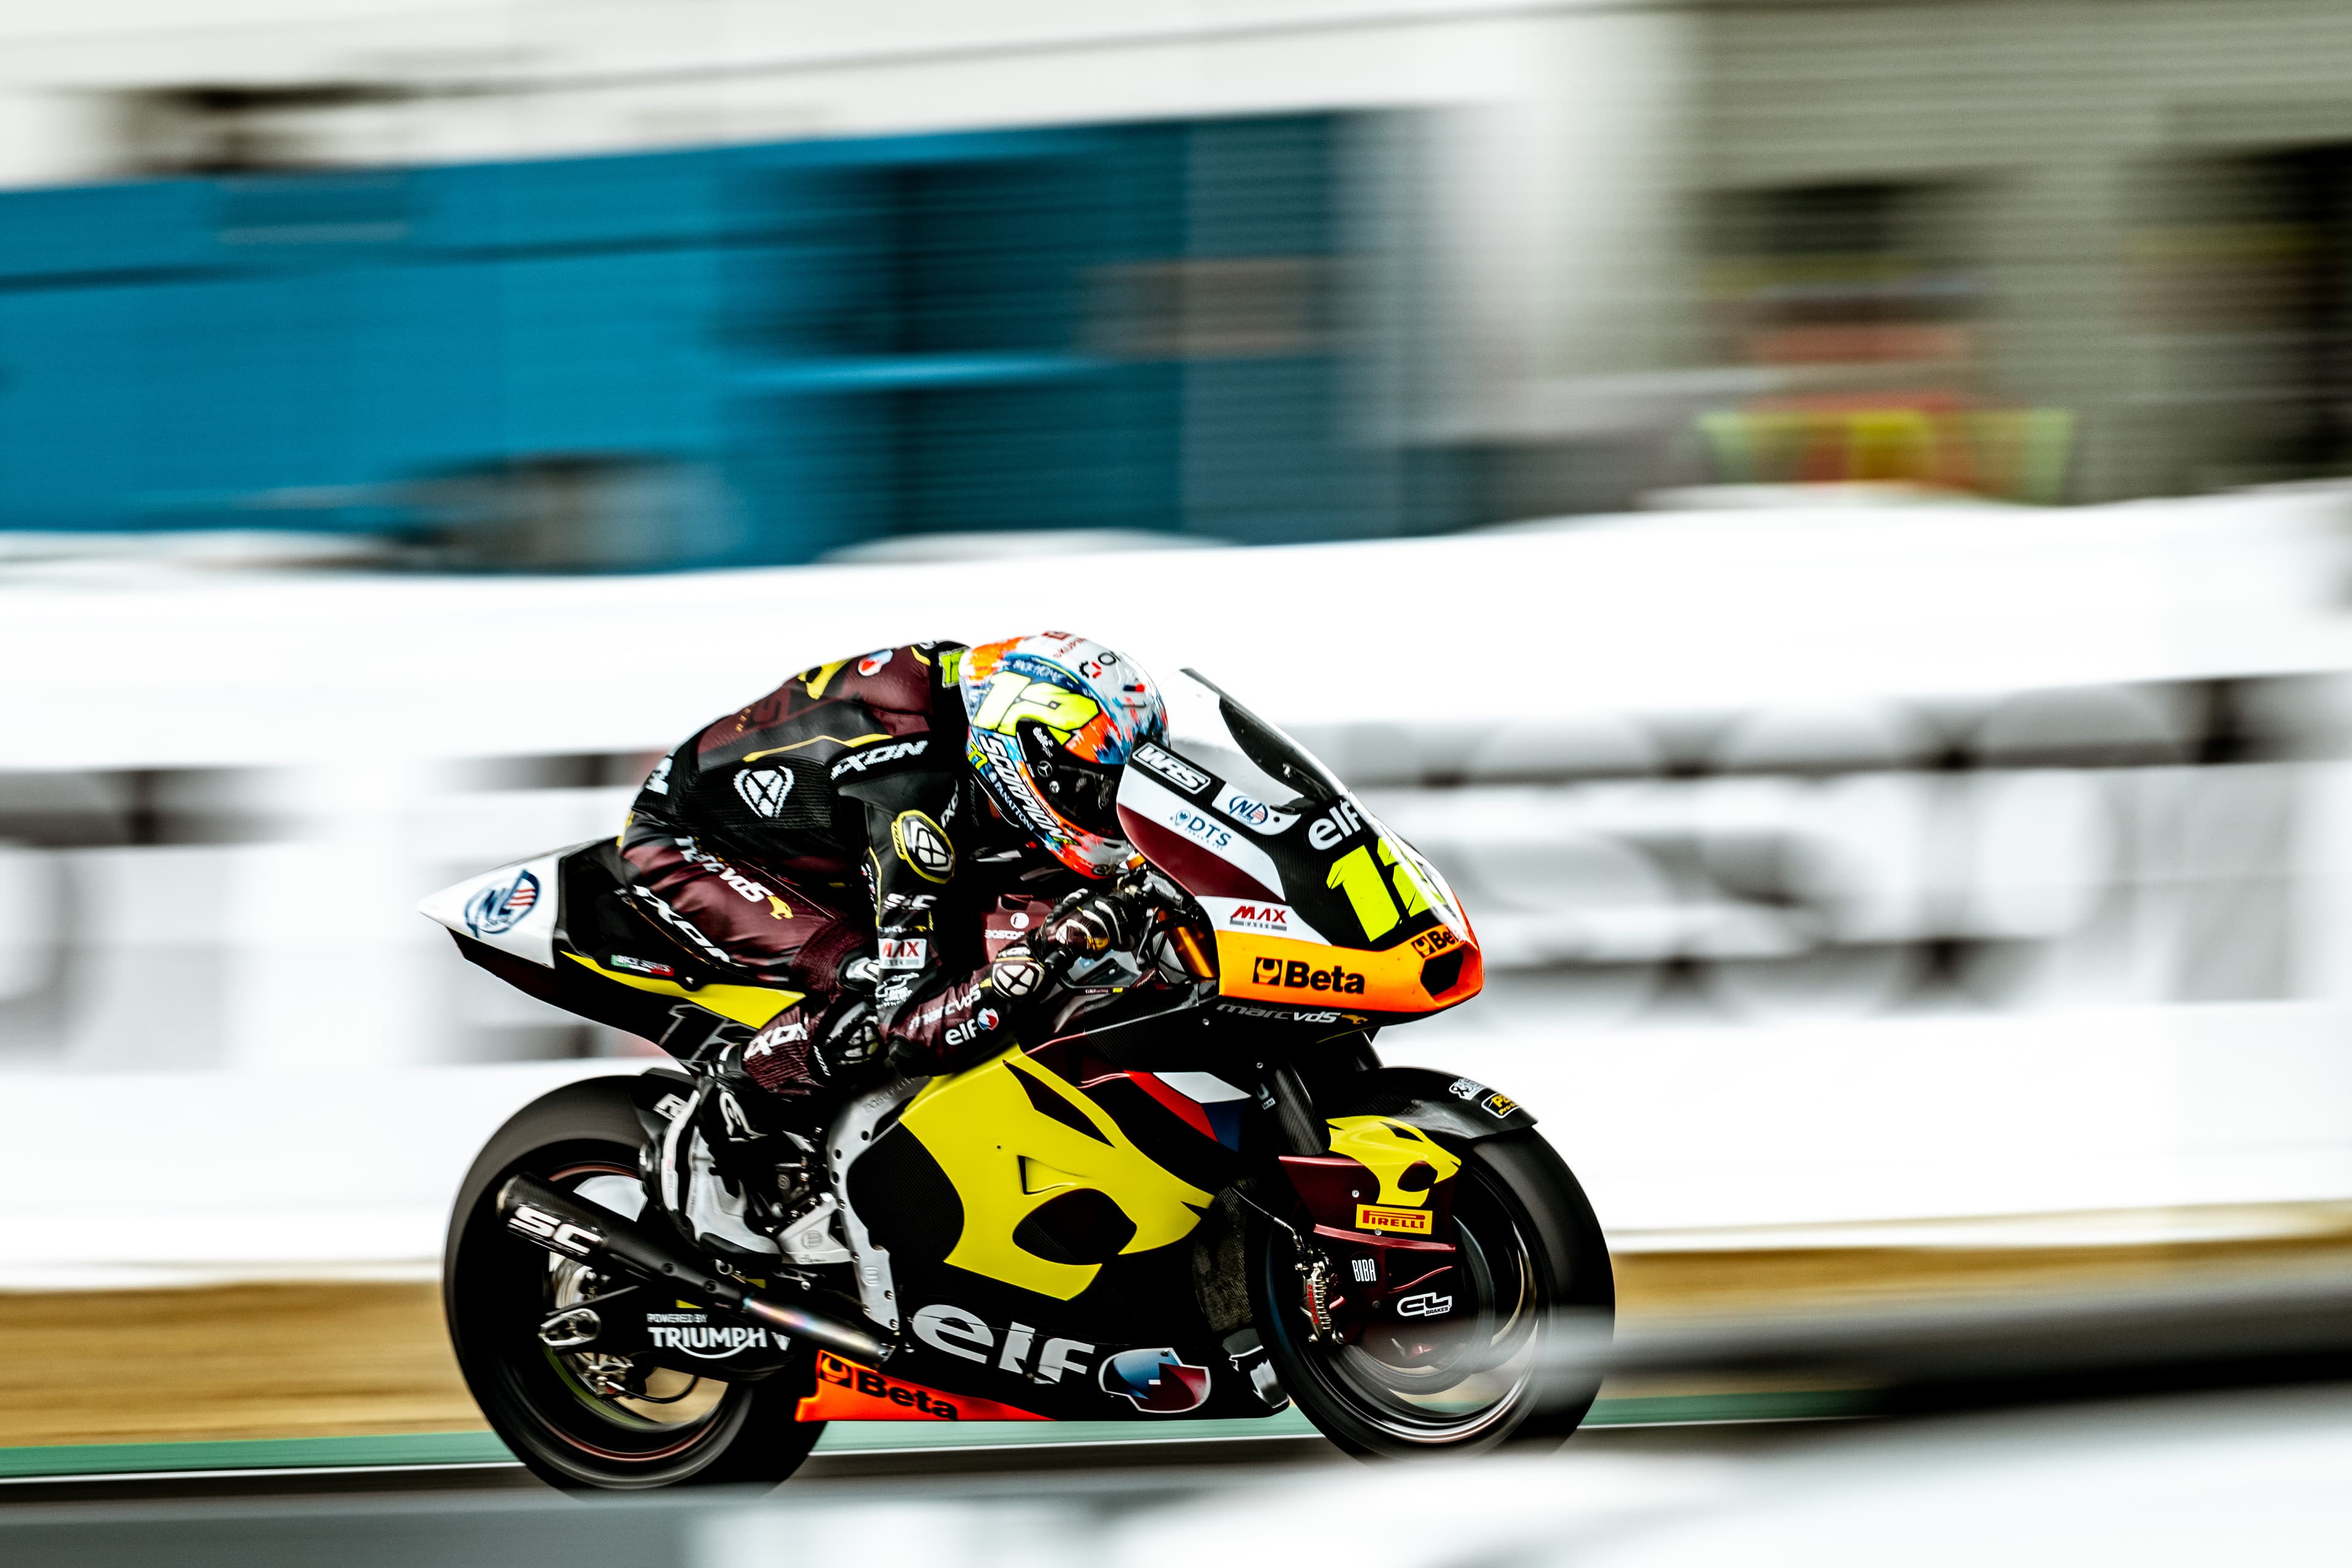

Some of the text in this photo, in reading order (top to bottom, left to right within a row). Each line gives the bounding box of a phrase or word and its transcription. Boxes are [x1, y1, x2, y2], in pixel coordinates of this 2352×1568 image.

[1138, 745, 1207, 788] WRS
[979, 734, 1072, 840] SCORPION
[1188, 816, 1232, 846] DTS
[1308, 800, 1362, 851] elf
[1326, 837, 1447, 943] 12
[1232, 905, 1287, 924] MAX
[883, 941, 919, 958] MAX
[1284, 960, 1366, 995] Beta
[944, 1019, 978, 1046] elf
[508, 1205, 603, 1254] SC
[1362, 1210, 1426, 1229] PIRELLI
[1352, 1258, 1377, 1282] BIBA
[647, 1313, 692, 1323] POWERED
[1425, 1306, 1449, 1315] BRAKES
[647, 1327, 767, 1359] TRIUMPH
[911, 1304, 1096, 1385] elf
[858, 1369, 958, 1421] Beta
